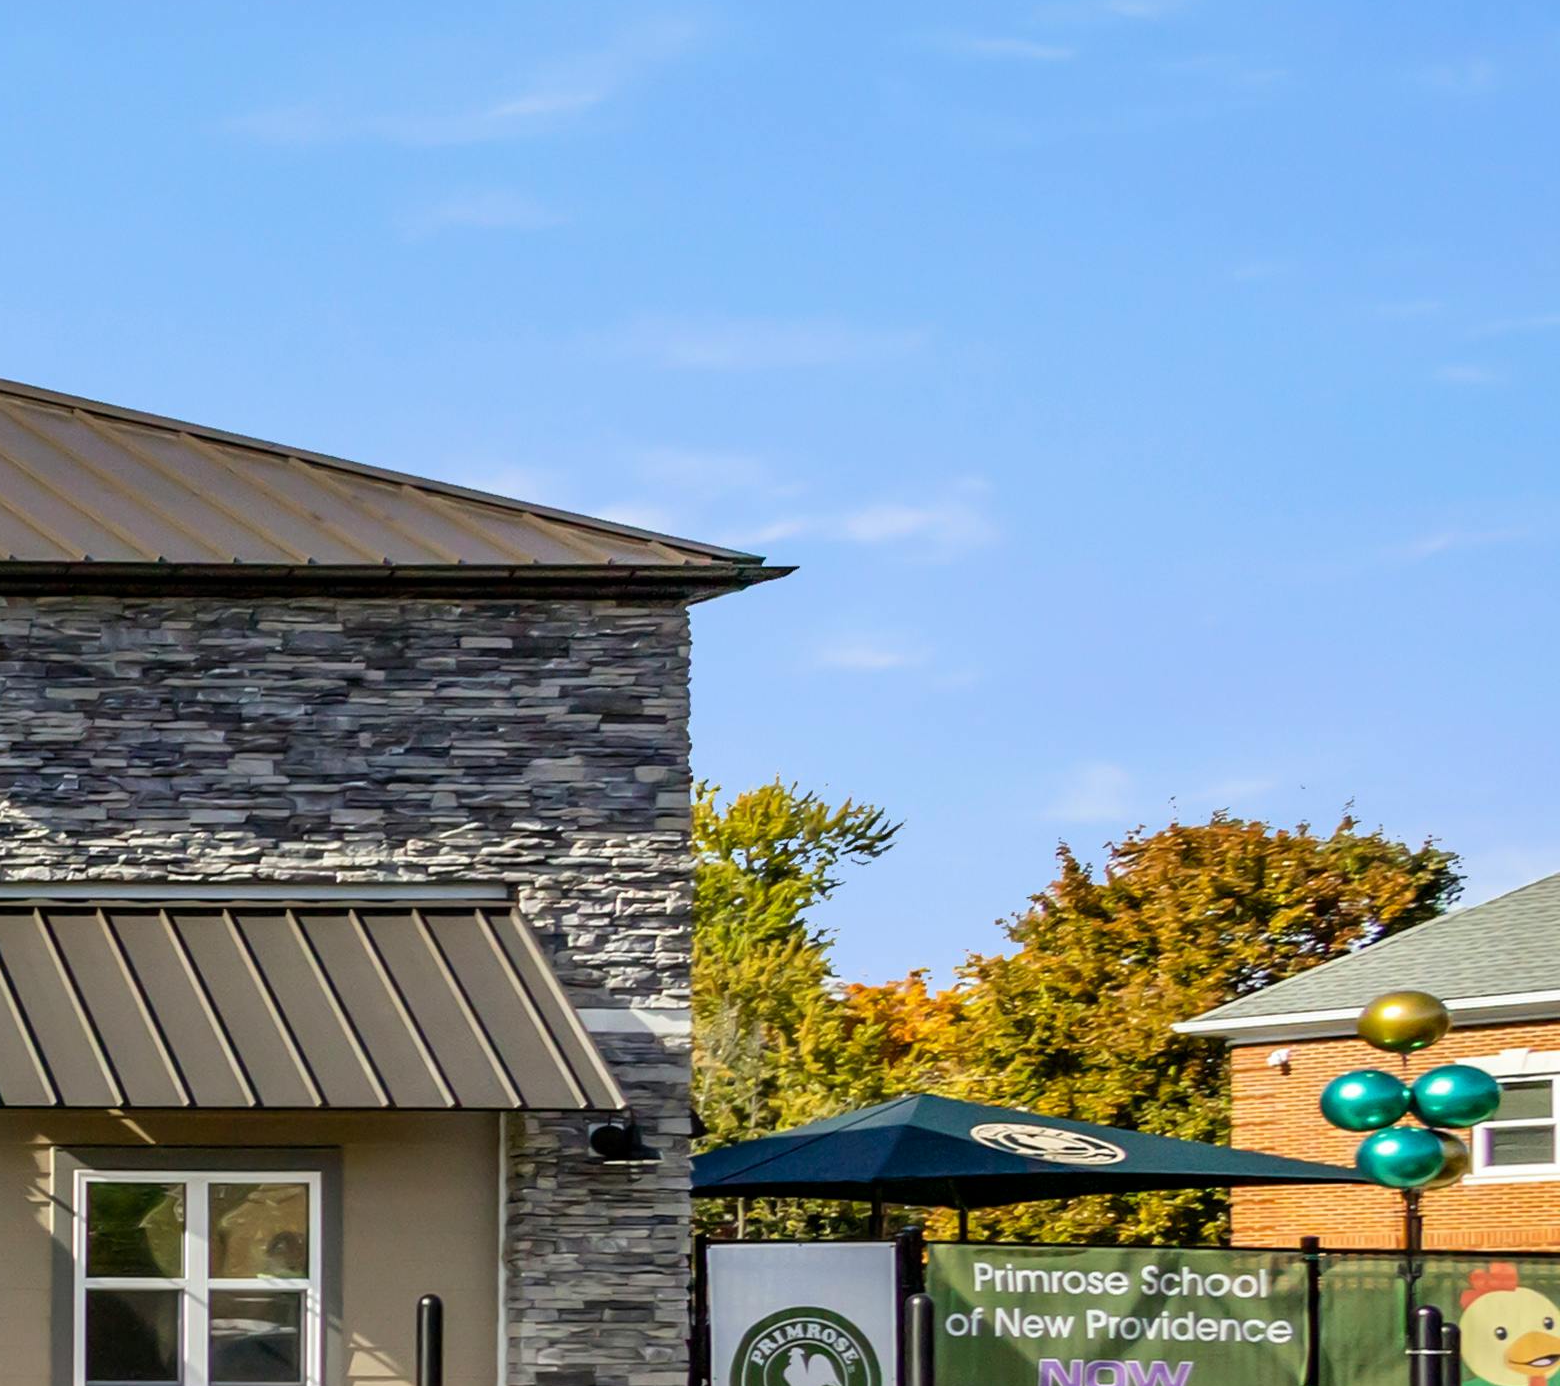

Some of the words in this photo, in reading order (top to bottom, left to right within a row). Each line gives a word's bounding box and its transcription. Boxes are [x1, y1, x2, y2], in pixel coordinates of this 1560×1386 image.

[973, 1263, 1128, 1295] Primrose
[1140, 1265, 1268, 1298] School
[945, 1308, 984, 1336] of
[994, 1308, 1074, 1339] New
[1086, 1310, 1293, 1344] Providence
[750, 1323, 860, 1366] PRIMROSE
